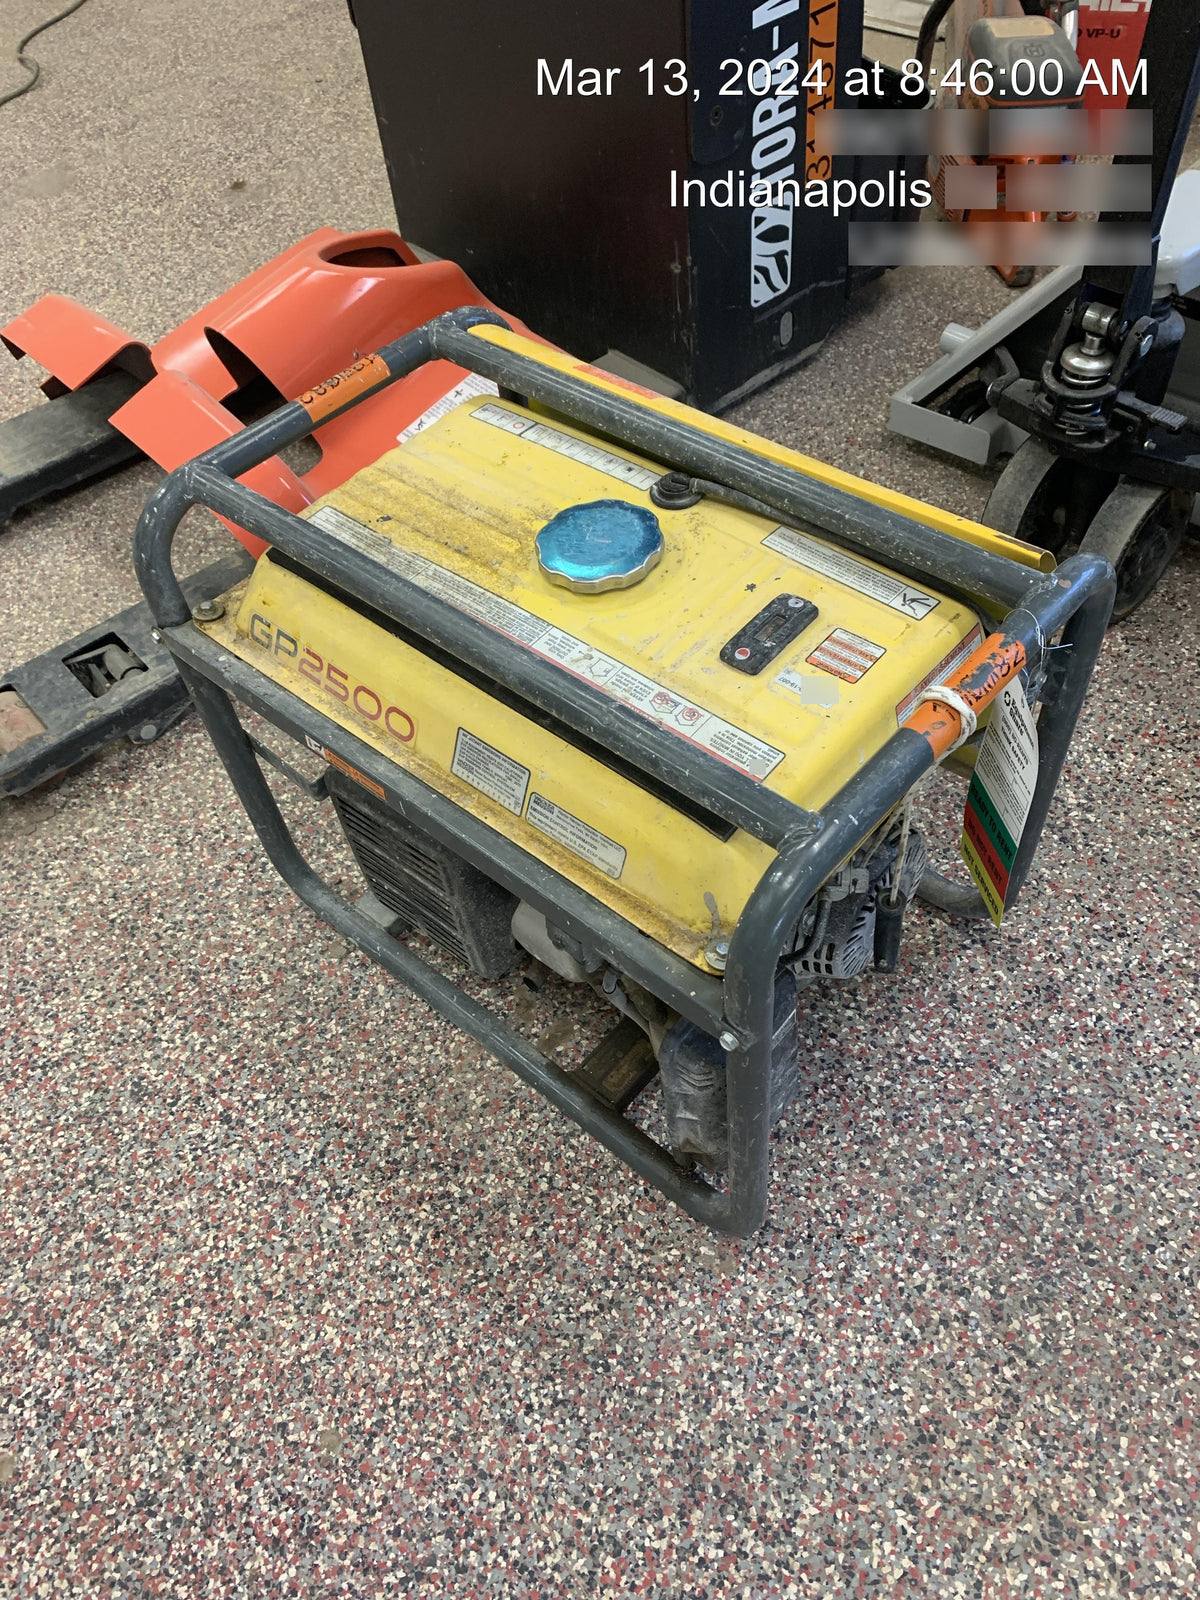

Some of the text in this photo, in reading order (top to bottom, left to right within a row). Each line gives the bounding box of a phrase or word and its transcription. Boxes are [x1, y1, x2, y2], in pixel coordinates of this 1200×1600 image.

[1086, 27, 1120, 38] VP-U
[805, 1, 836, 181] 34371
[250, 612, 416, 743] GP2500
[1008, 706, 1024, 737] Share
[996, 828, 1012, 862] RENT
[963, 842, 999, 915] NOT SERVICED
